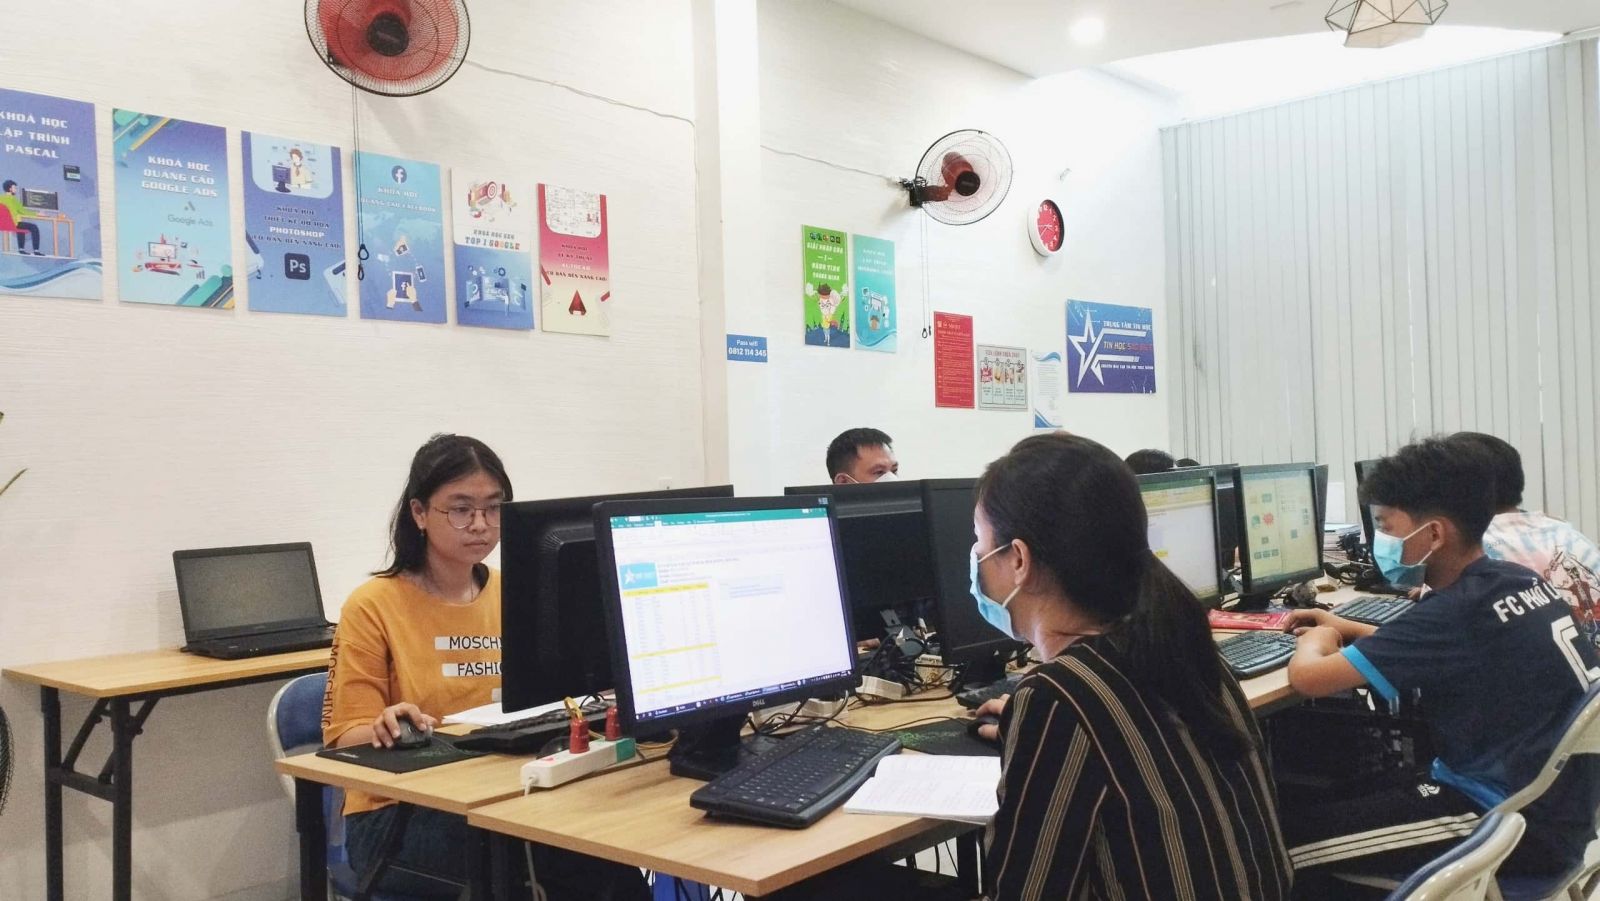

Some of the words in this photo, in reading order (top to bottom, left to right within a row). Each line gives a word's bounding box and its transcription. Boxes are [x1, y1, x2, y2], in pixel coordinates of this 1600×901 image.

[41, 117, 69, 129] HỌC
[28, 131, 70, 145] TRÌNH
[5, 144, 60, 159] PASCAL
[141, 180, 190, 194] GOOGLE
[193, 187, 218, 197] ADS
[168, 214, 196, 226] Google
[198, 218, 214, 227] Ads
[269, 226, 325, 238] PHOTOSHOP
[465, 236, 481, 245] TOP
[489, 239, 520, 250] GOOGLE
[289, 259, 307, 274] Ps
[728, 347, 744, 355] 0812
[755, 349, 767, 357] 345
[1493, 595, 1525, 623] FC
[457, 661, 502, 677] FASHI
